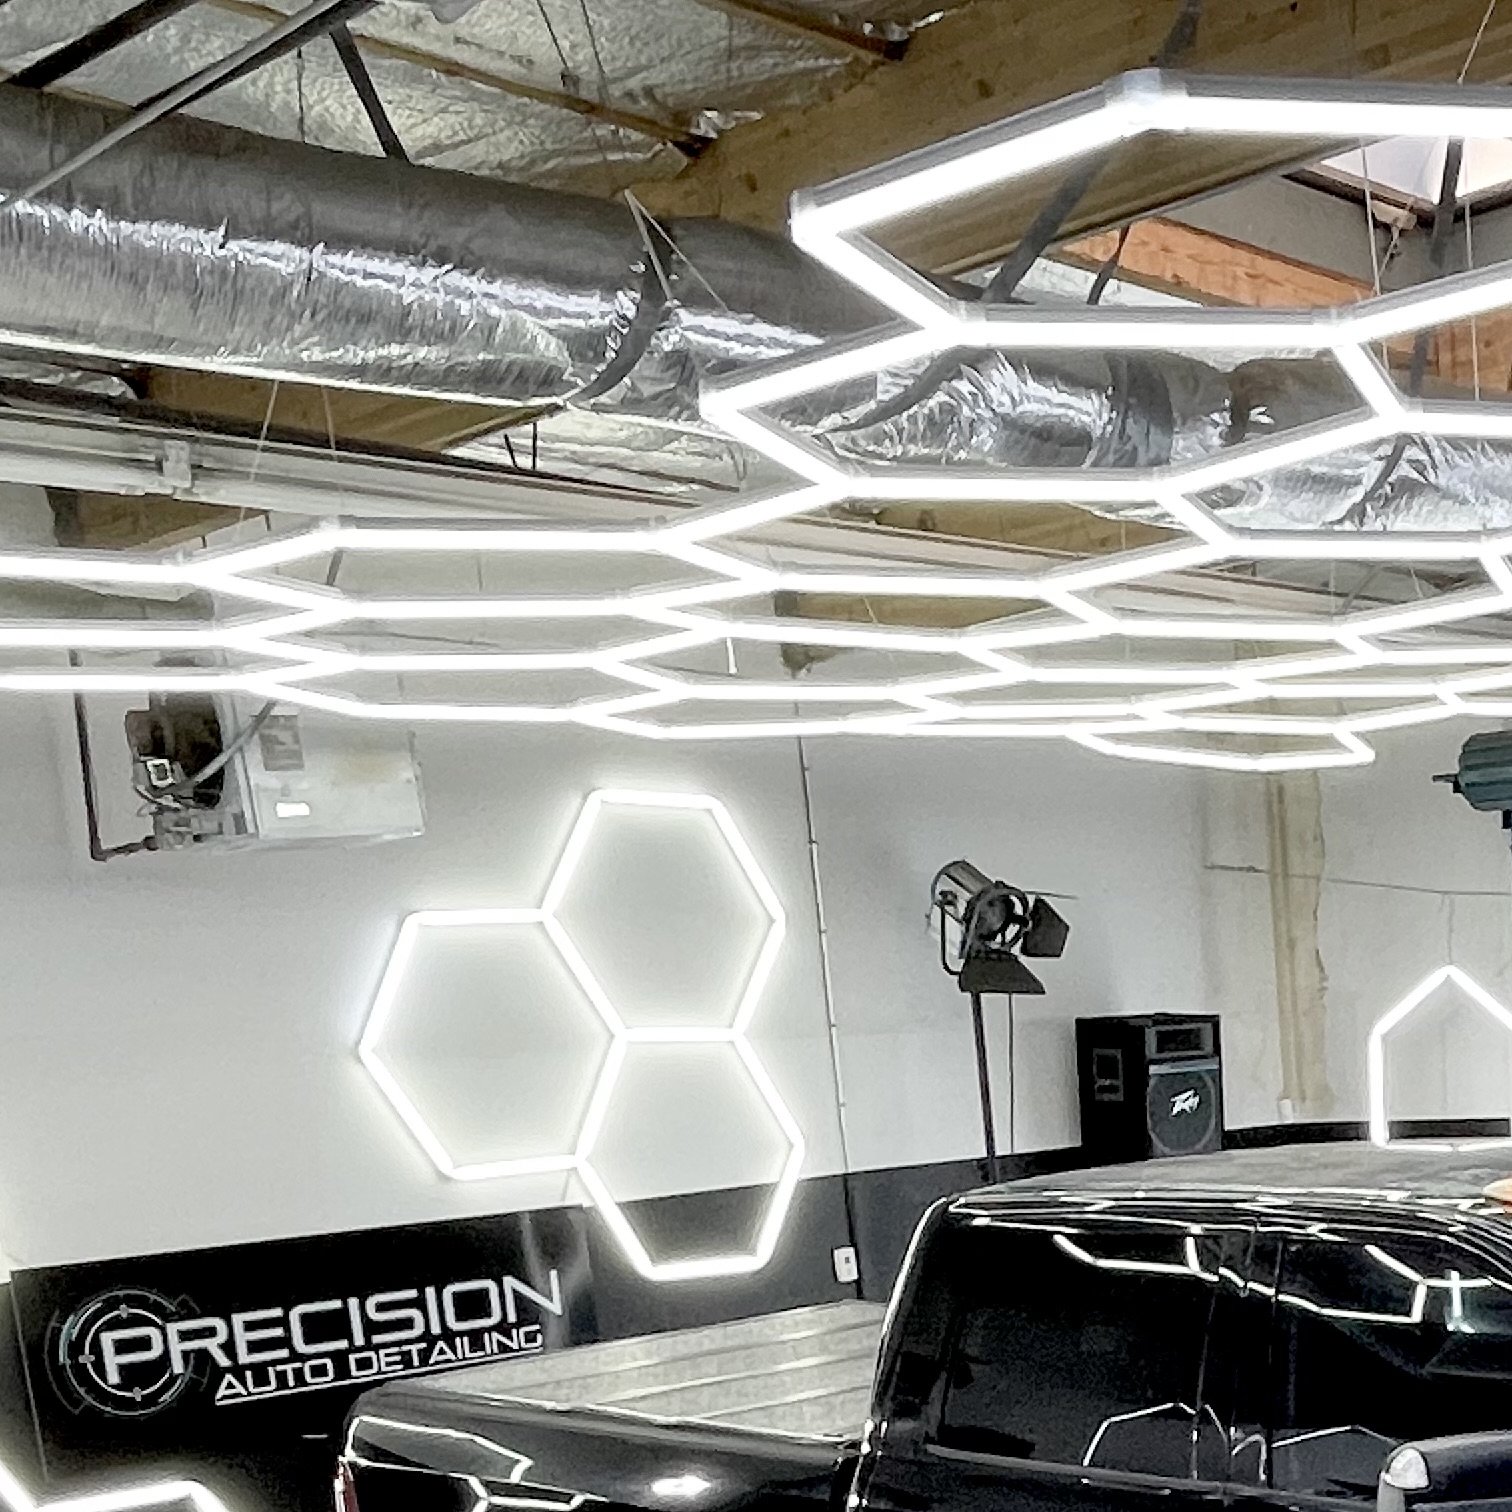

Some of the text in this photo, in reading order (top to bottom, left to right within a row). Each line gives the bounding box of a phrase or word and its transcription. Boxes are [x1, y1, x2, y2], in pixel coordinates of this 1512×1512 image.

[99, 1268, 563, 1386] PRECISION
[214, 1323, 544, 1401] AUTO DETAILING
